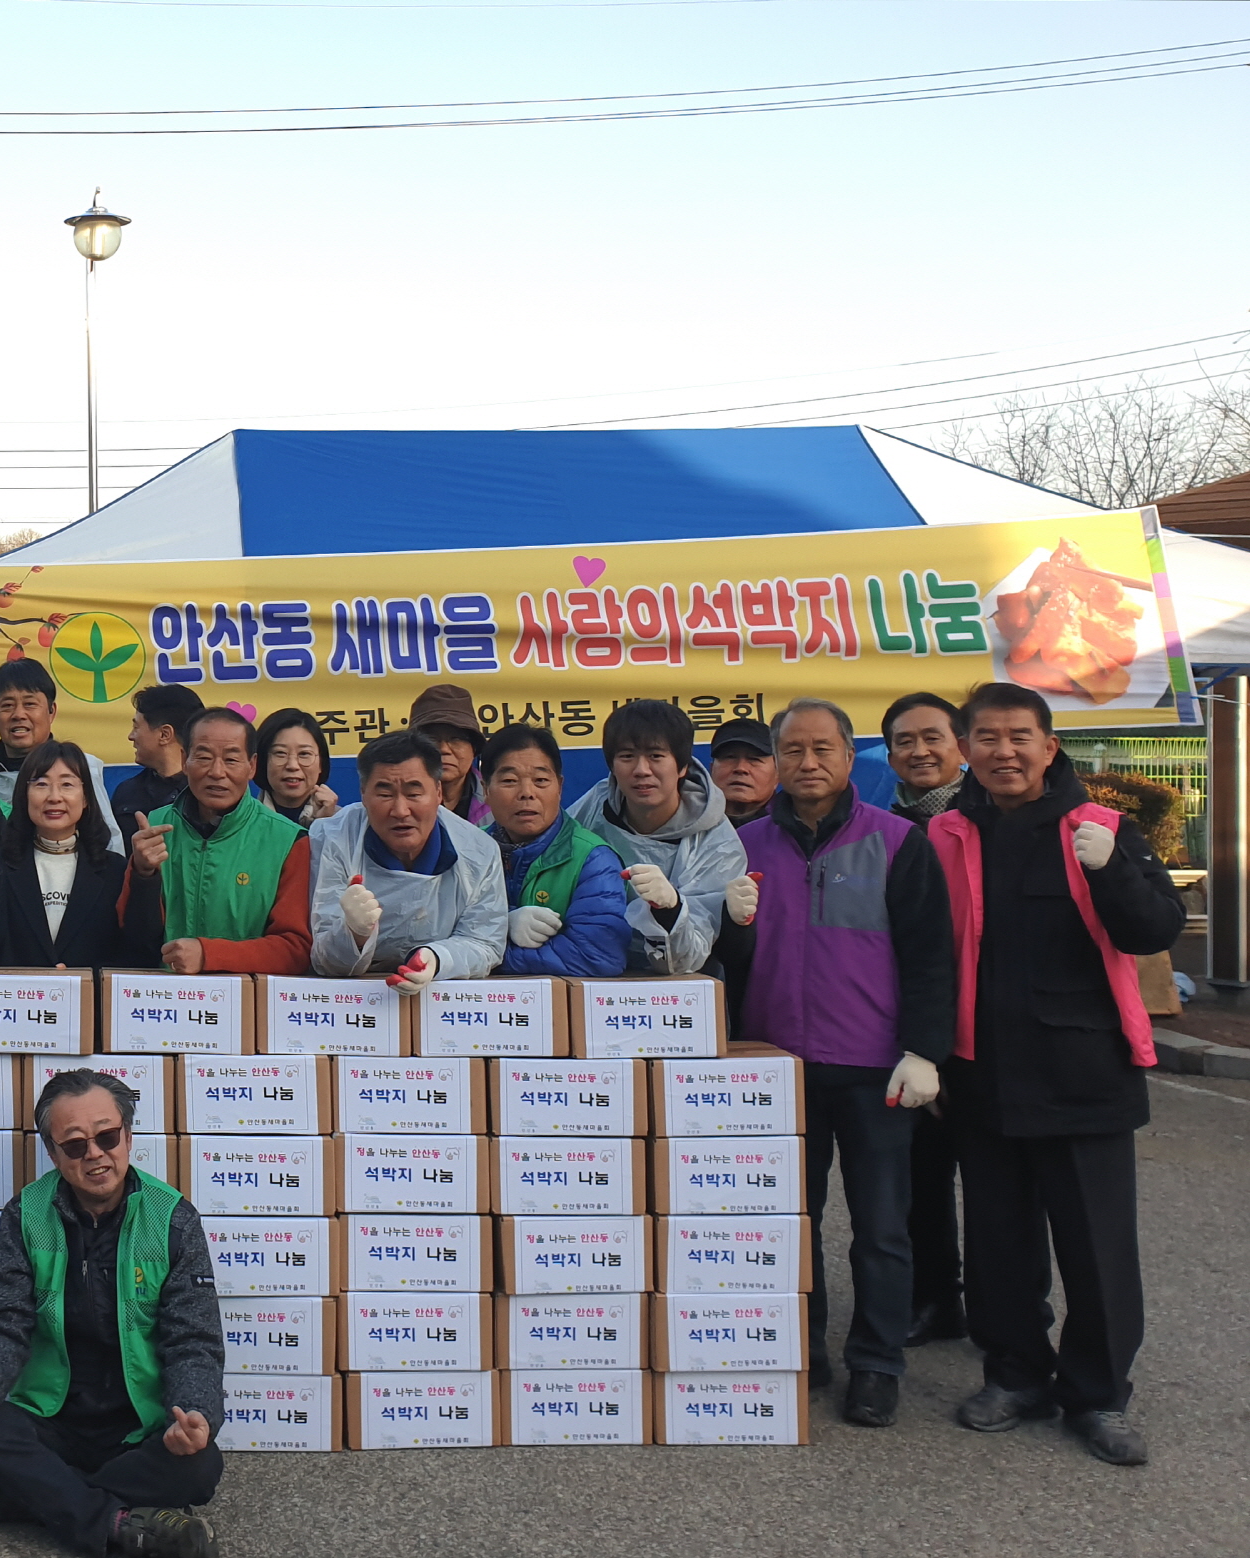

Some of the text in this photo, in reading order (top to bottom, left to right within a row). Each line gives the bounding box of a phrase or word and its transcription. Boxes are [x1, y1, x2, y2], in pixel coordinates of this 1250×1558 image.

[150, 570, 989, 684] 안산동 새마을 사랑의석박지 나눔
[315, 707, 390, 745] 주관
[477, 700, 596, 739] 안산동
[17, 989, 45, 1000] 안산동
[280, 993, 363, 1004] 정을 나누는 안산동
[596, 996, 679, 1005] 정을 나누는 안산동
[28, 1010, 57, 1024] 나눔
[288, 1012, 376, 1028] 석박지 나눔
[605, 1015, 692, 1029] 석박지 나눔
[197, 1065, 280, 1077] 정을 나누는 안산동
[512, 1072, 596, 1083] 정을 나누는 안산동
[206, 1087, 293, 1101] 석박지 나눔
[521, 1092, 609, 1107] 석박지 나눔
[357, 1148, 440, 1159] 정을 나누는 안산동
[681, 1155, 763, 1164] 정을 나누는 안산동
[365, 1167, 453, 1183] 석박지 나눔
[690, 1174, 776, 1187] 석박지 나눔
[527, 1234, 608, 1243] 정을 나누는 안산동
[535, 1253, 621, 1267] 석박지 나눔
[360, 1308, 443, 1318] 정을 나누는 안산동
[680, 1308, 763, 1319] 정을 나누는 안산동
[369, 1328, 456, 1342] 석박지 나눔
[689, 1327, 776, 1343] 석박지 나눔
[677, 1384, 760, 1393] 정을 나누는 안산동
[686, 1403, 773, 1417] 석박지 나눔
